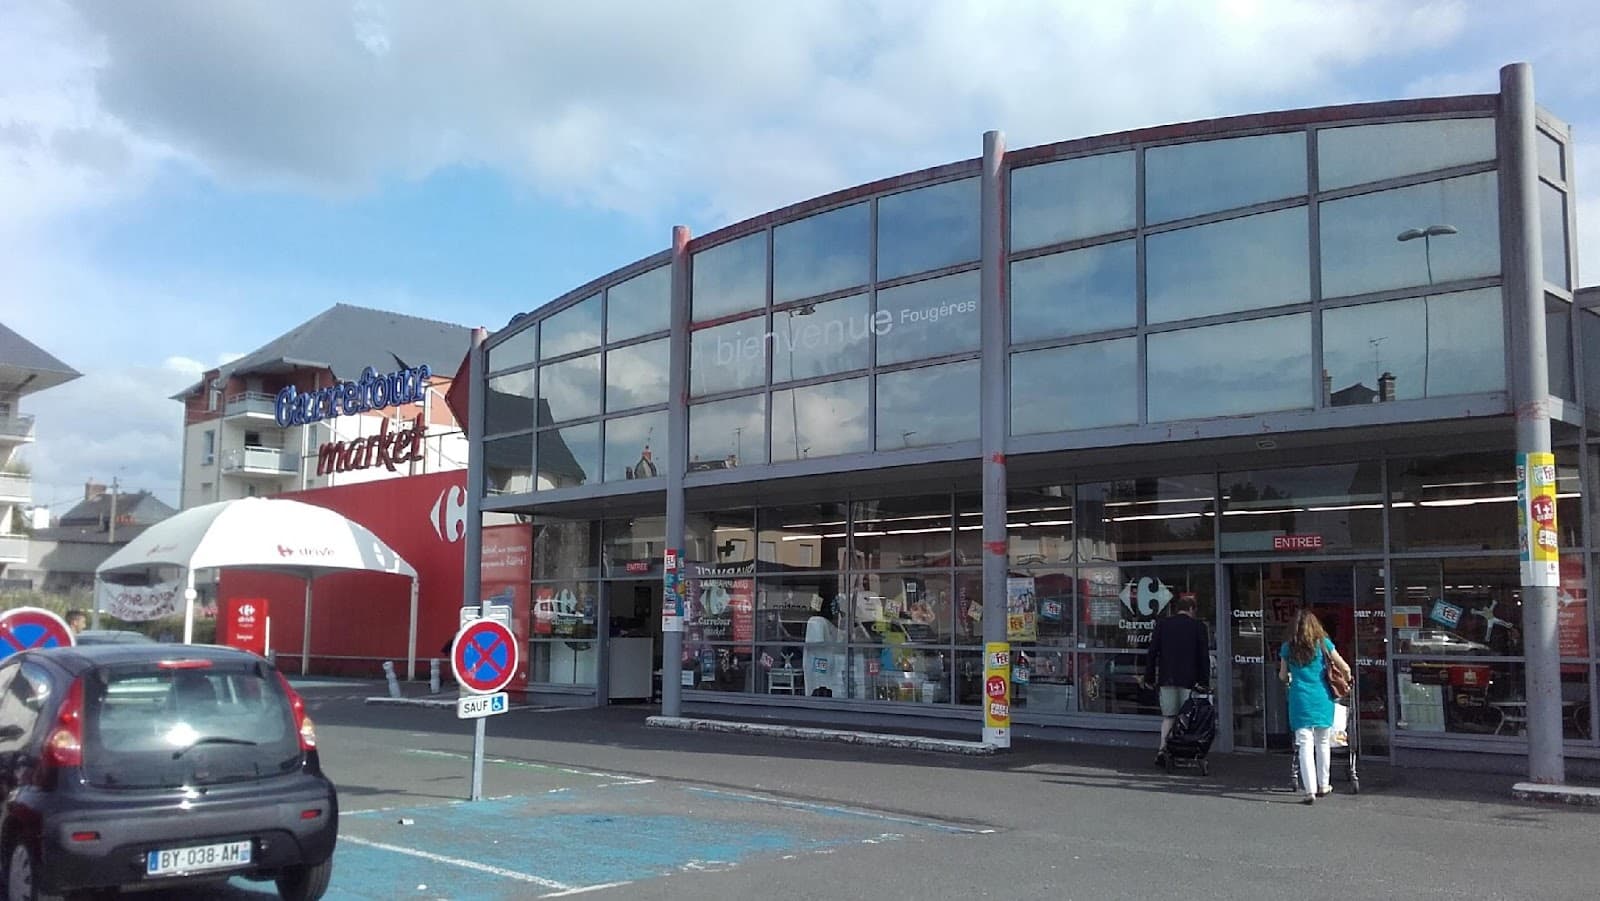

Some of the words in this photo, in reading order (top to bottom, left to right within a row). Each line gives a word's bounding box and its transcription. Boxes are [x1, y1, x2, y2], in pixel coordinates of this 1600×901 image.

[717, 308, 893, 366] bienvenue
[901, 299, 977, 325] Fougères
[274, 364, 432, 428] Carrefour
[317, 412, 427, 476] market
[1274, 535, 1322, 548] ENTREE
[463, 701, 489, 714] SAUF
[161, 844, 240, 869] BY-038-AM
